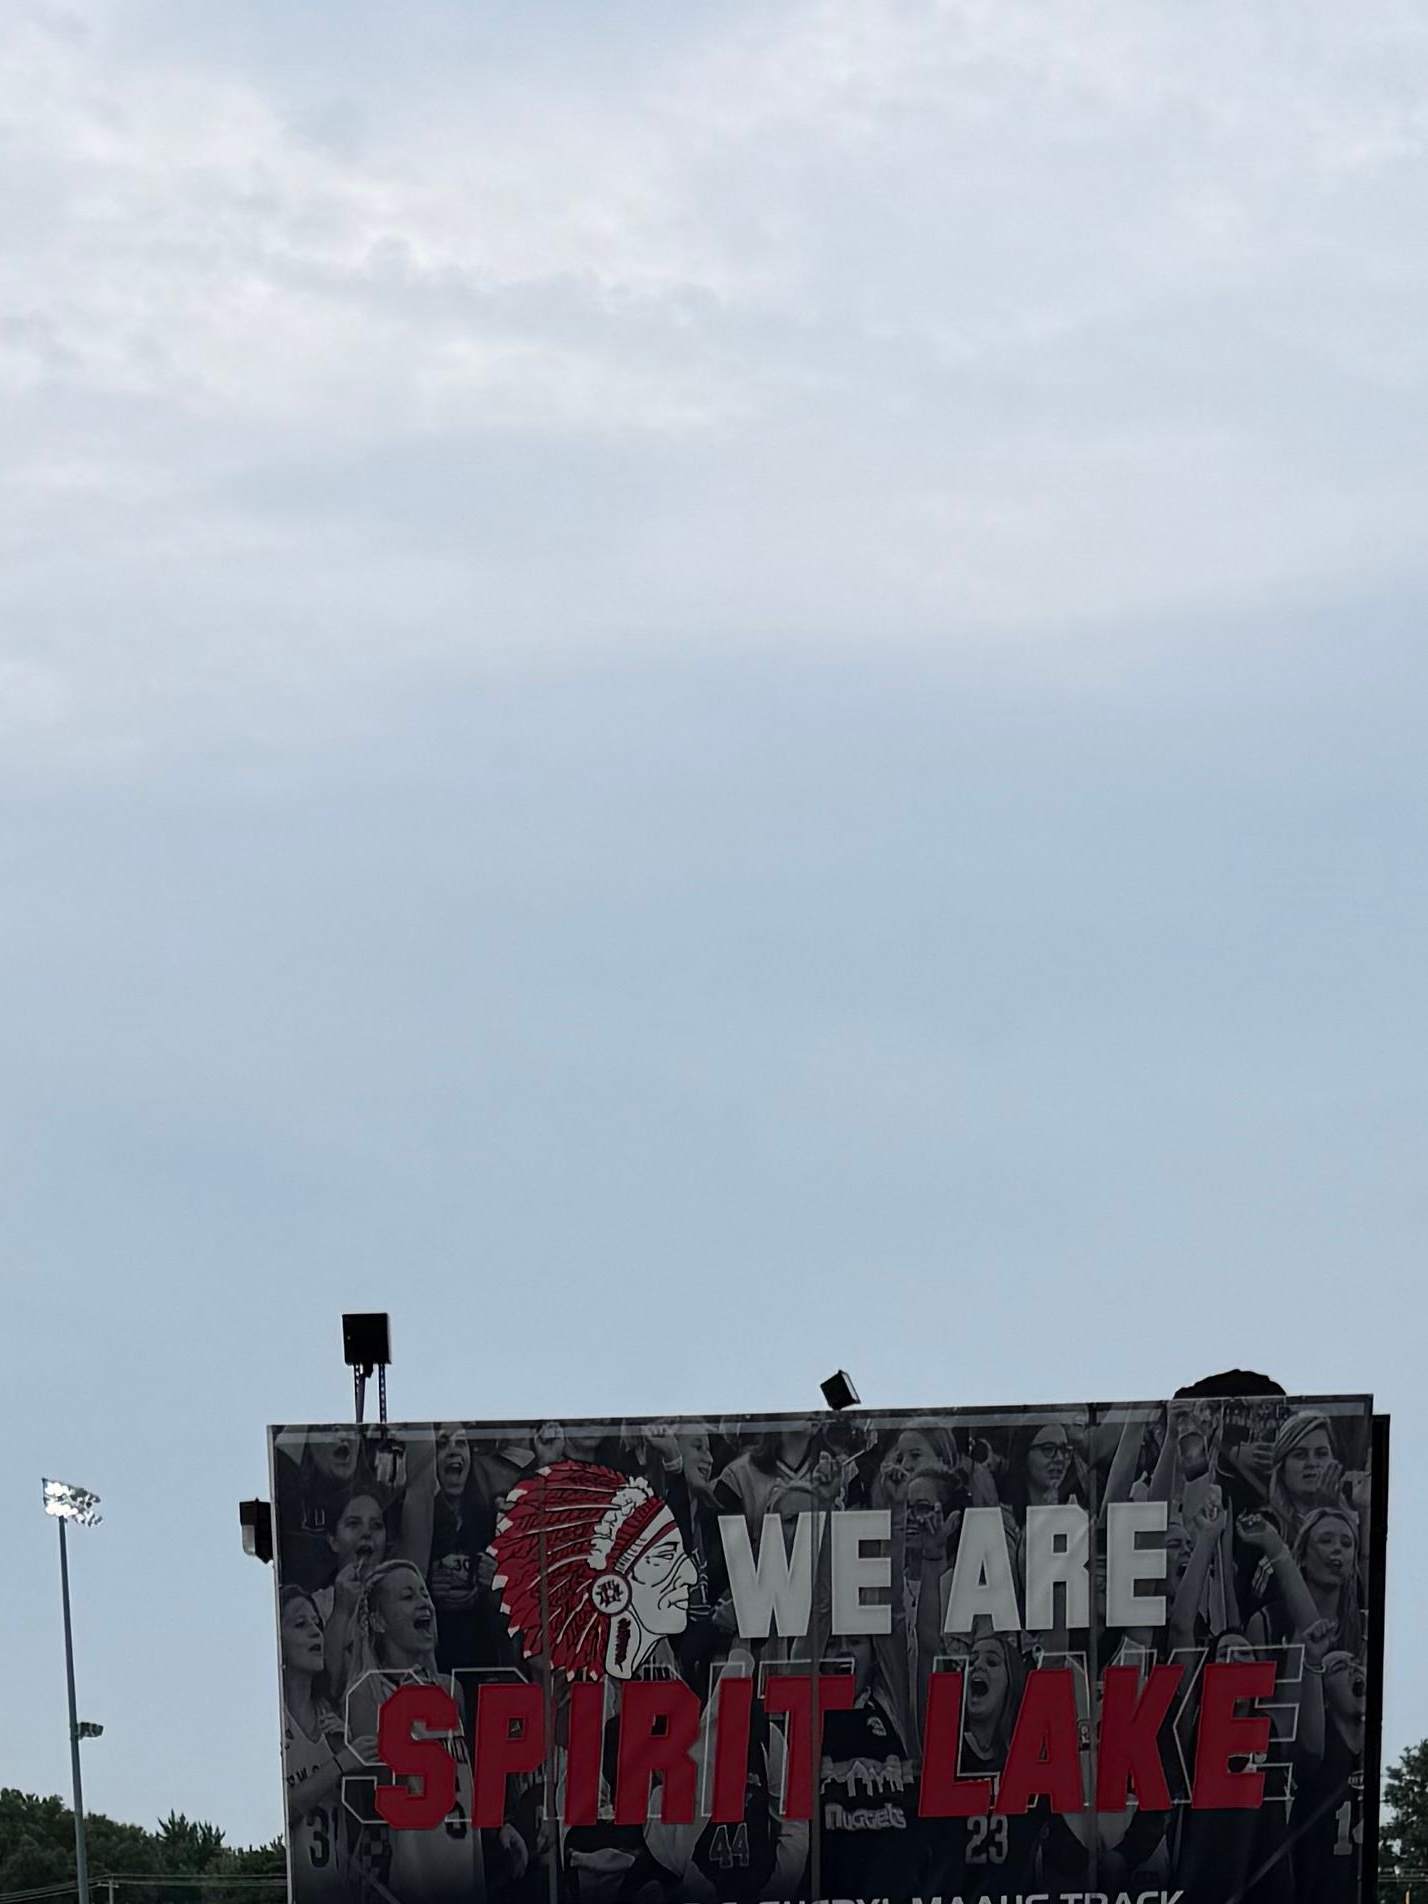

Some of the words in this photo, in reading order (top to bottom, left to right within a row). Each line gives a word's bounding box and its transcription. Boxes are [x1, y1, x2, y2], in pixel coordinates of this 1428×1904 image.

[717, 1509, 892, 1639] WE
[944, 1500, 1169, 1633] ARE
[372, 1673, 857, 1831] SPIRIT
[916, 1660, 1277, 1819] LAKE
[708, 1821, 751, 1869] 44
[964, 1814, 1009, 1865] 23
